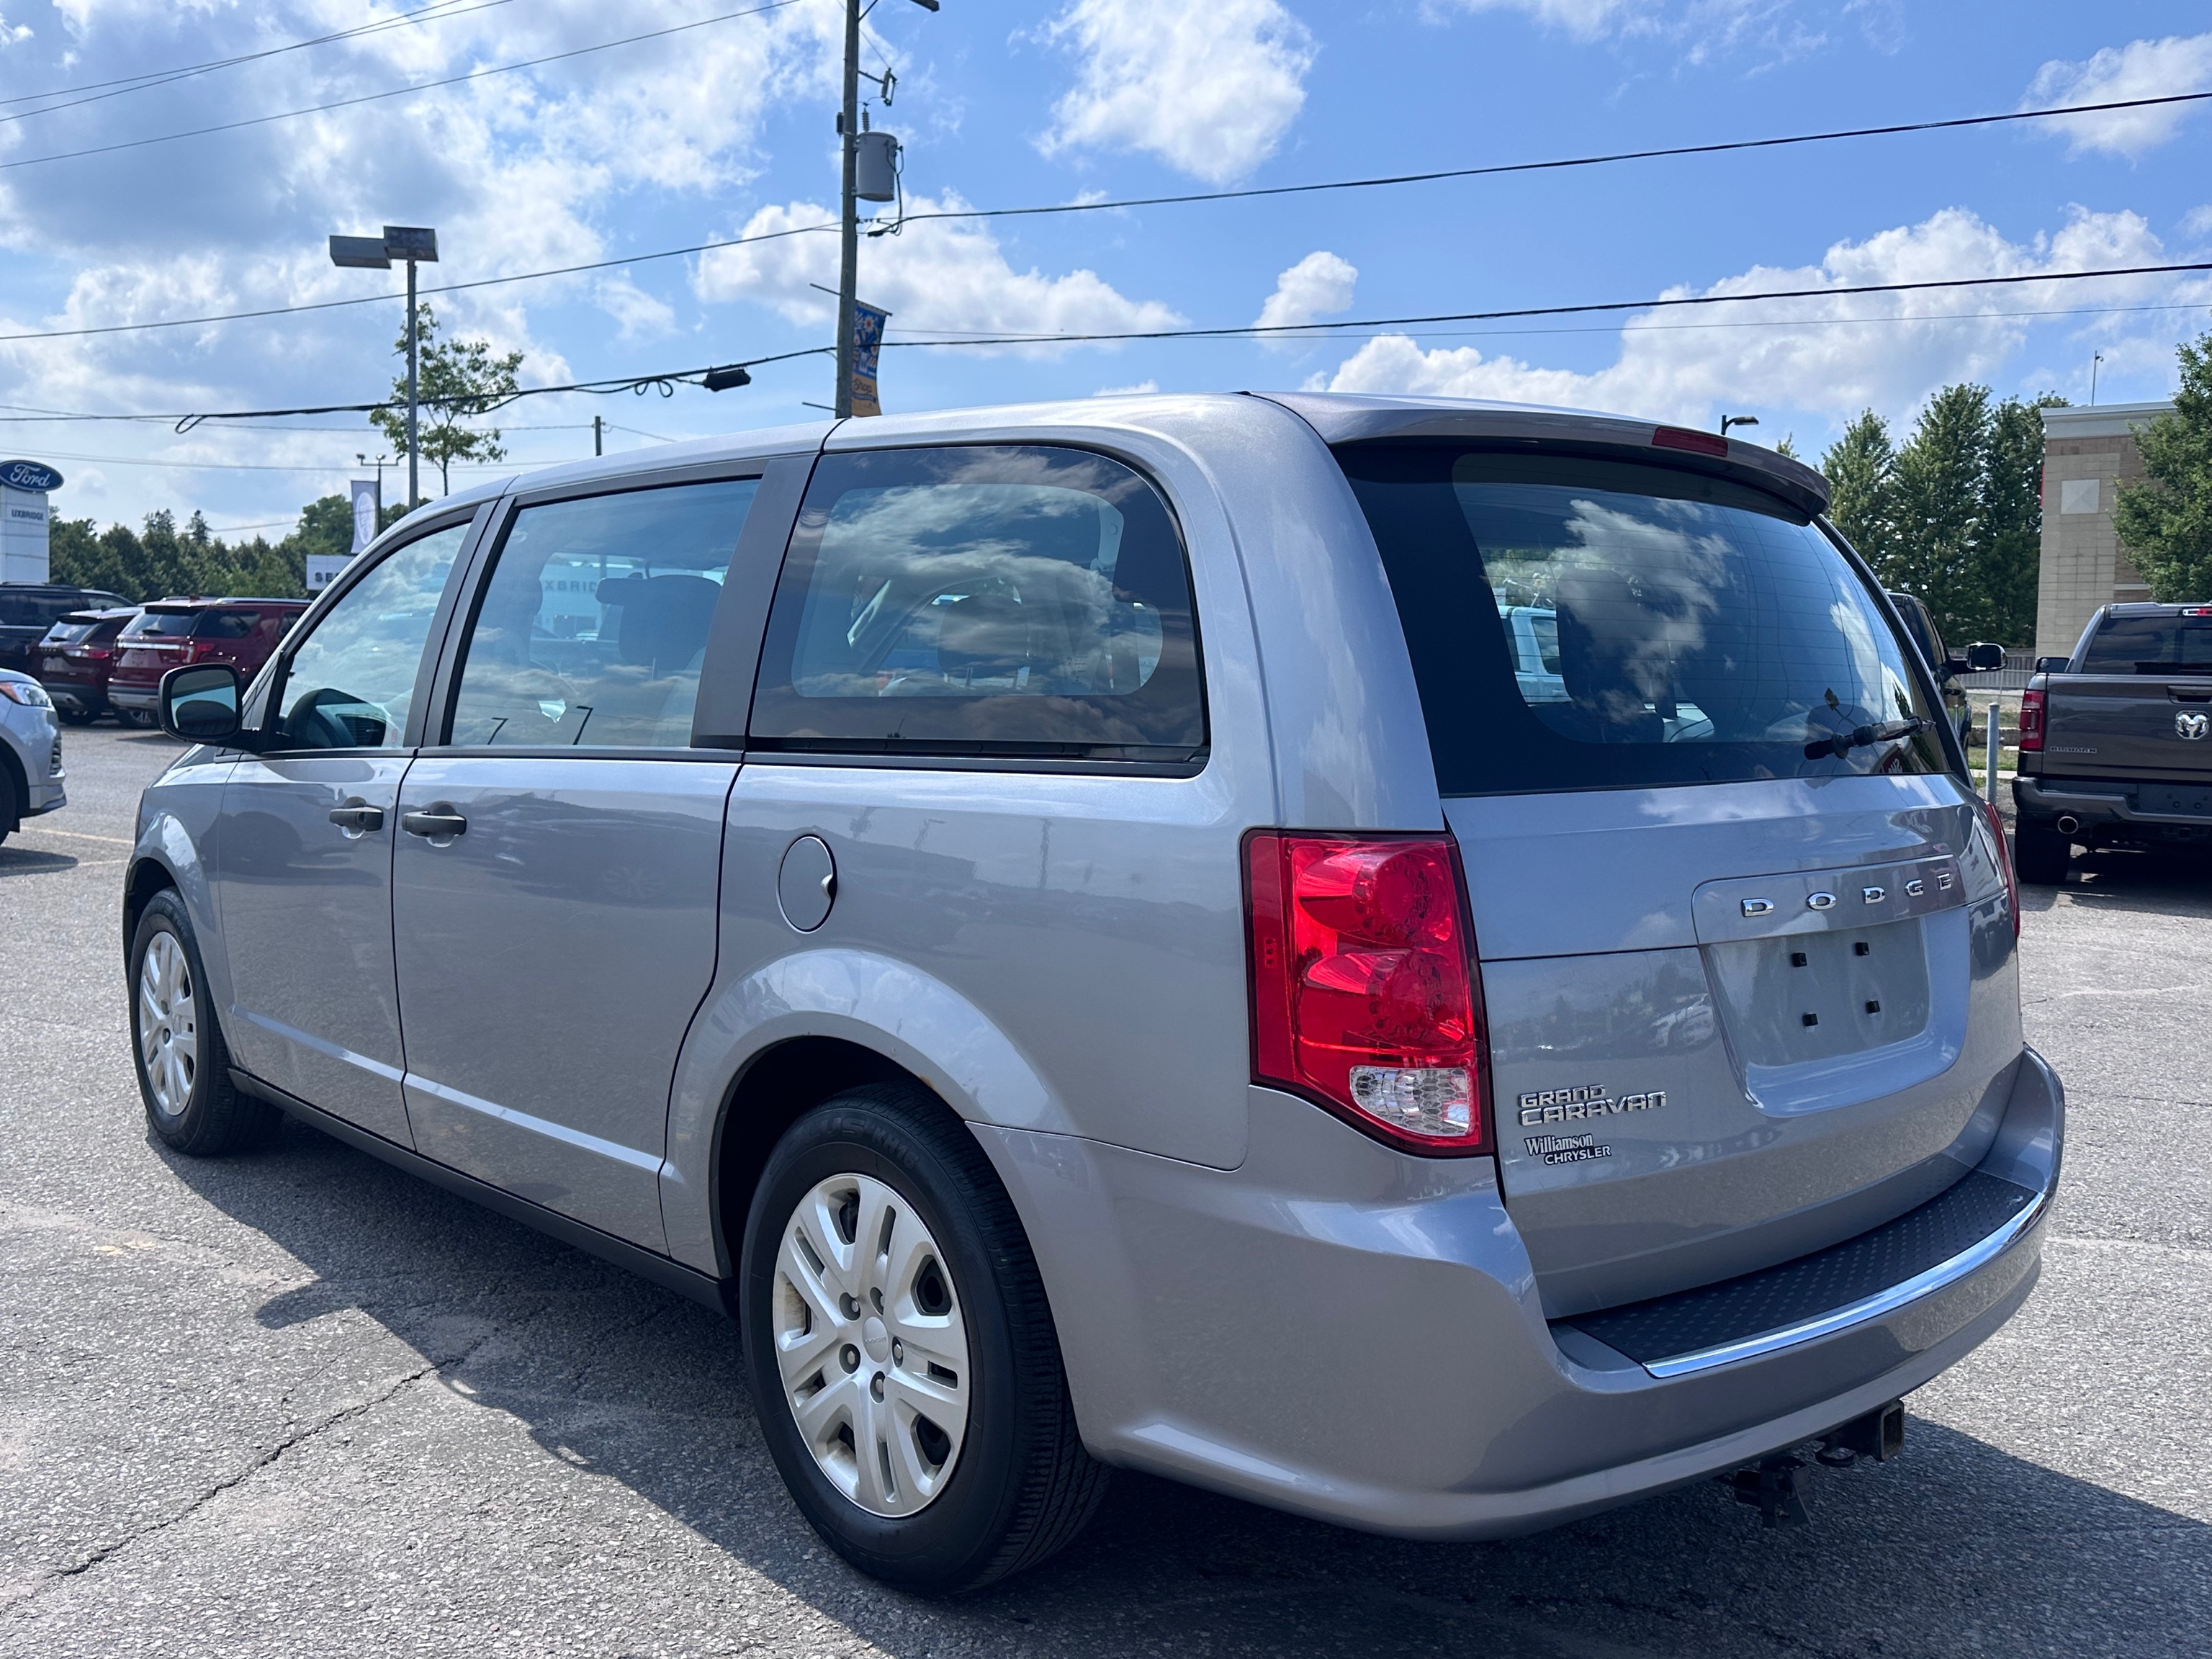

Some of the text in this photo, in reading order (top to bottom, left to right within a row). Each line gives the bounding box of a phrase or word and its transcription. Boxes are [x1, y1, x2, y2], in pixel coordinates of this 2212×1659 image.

[9, 463, 51, 487] Ford
[314, 572, 341, 583] SE
[1741, 872, 1953, 917] DODGE
[1520, 1084, 1606, 1108] GRAND
[1520, 1091, 1667, 1126] CARAVAN
[1524, 1133, 1594, 1156] Williamson
[1544, 1146, 1611, 1165] CHRYSLER
